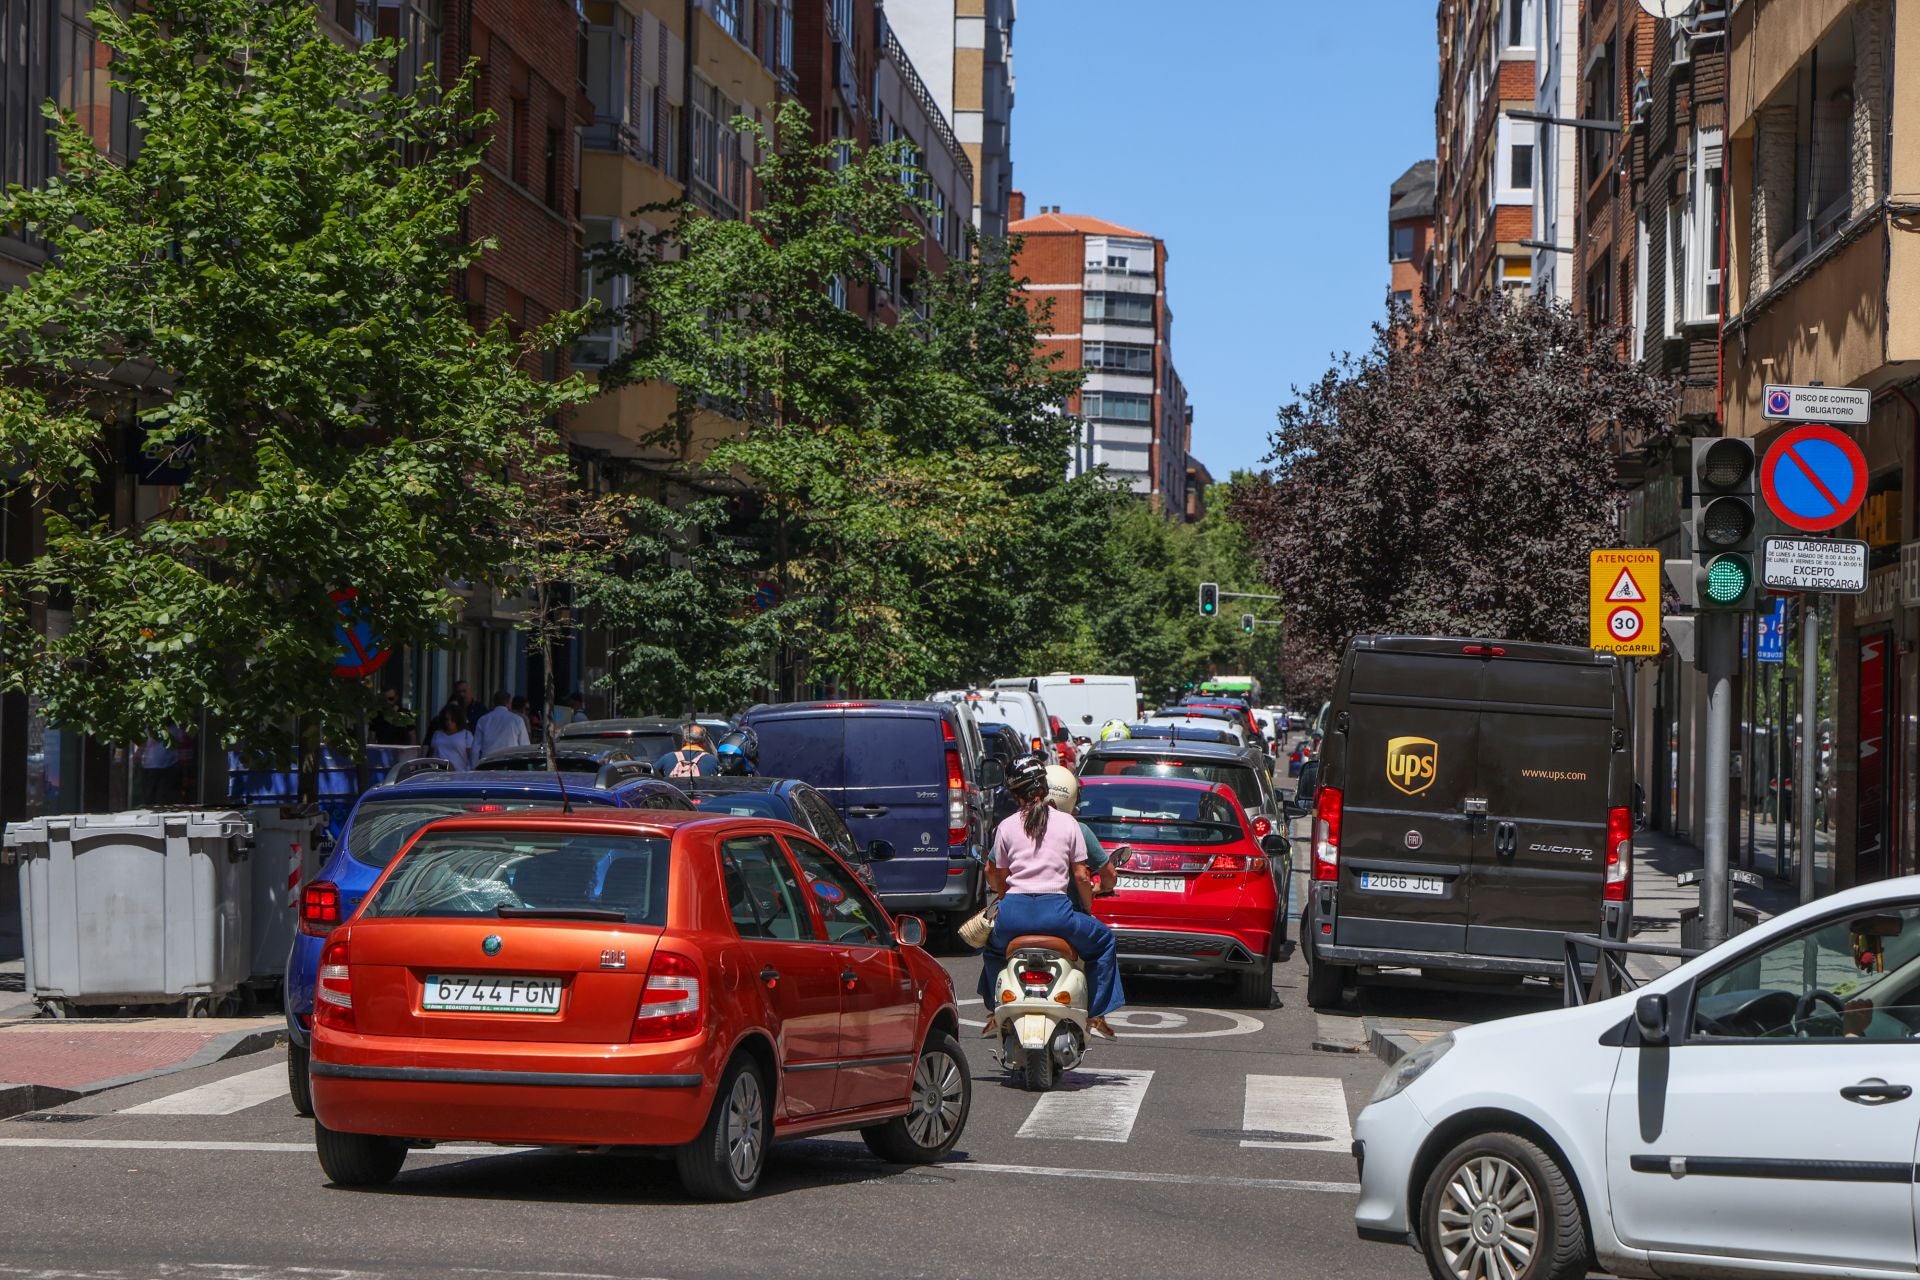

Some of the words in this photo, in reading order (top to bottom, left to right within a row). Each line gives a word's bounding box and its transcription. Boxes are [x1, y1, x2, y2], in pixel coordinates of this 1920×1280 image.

[1795, 394, 1817, 402] DISCO
[1819, 395, 1828, 403] DE
[1830, 396, 1864, 405] CONTROL
[1805, 406, 1854, 415] OBLIGATORIO
[1774, 540, 1794, 550] DIAS
[1797, 543, 1857, 554] LABORABLES
[1793, 565, 1835, 577] EXCEPTO
[1767, 575, 1798, 585] CARGA
[1802, 577, 1808, 586] Y
[1811, 578, 1860, 589] DESCARGA
[1614, 617, 1636, 630] 30
[1593, 644, 1656, 653] CICLOCARRIL
[1390, 754, 1433, 785] ups
[1521, 769, 1586, 781] www.ups.com
[1408, 835, 1419, 845] FIAT
[1528, 843, 1593, 856] DUCATO
[1154, 878, 1181, 890] FRV
[1371, 874, 1407, 889] 2066
[1413, 877, 1439, 892] JCL
[438, 978, 502, 1002] 6744
[509, 980, 556, 1004] FGN
